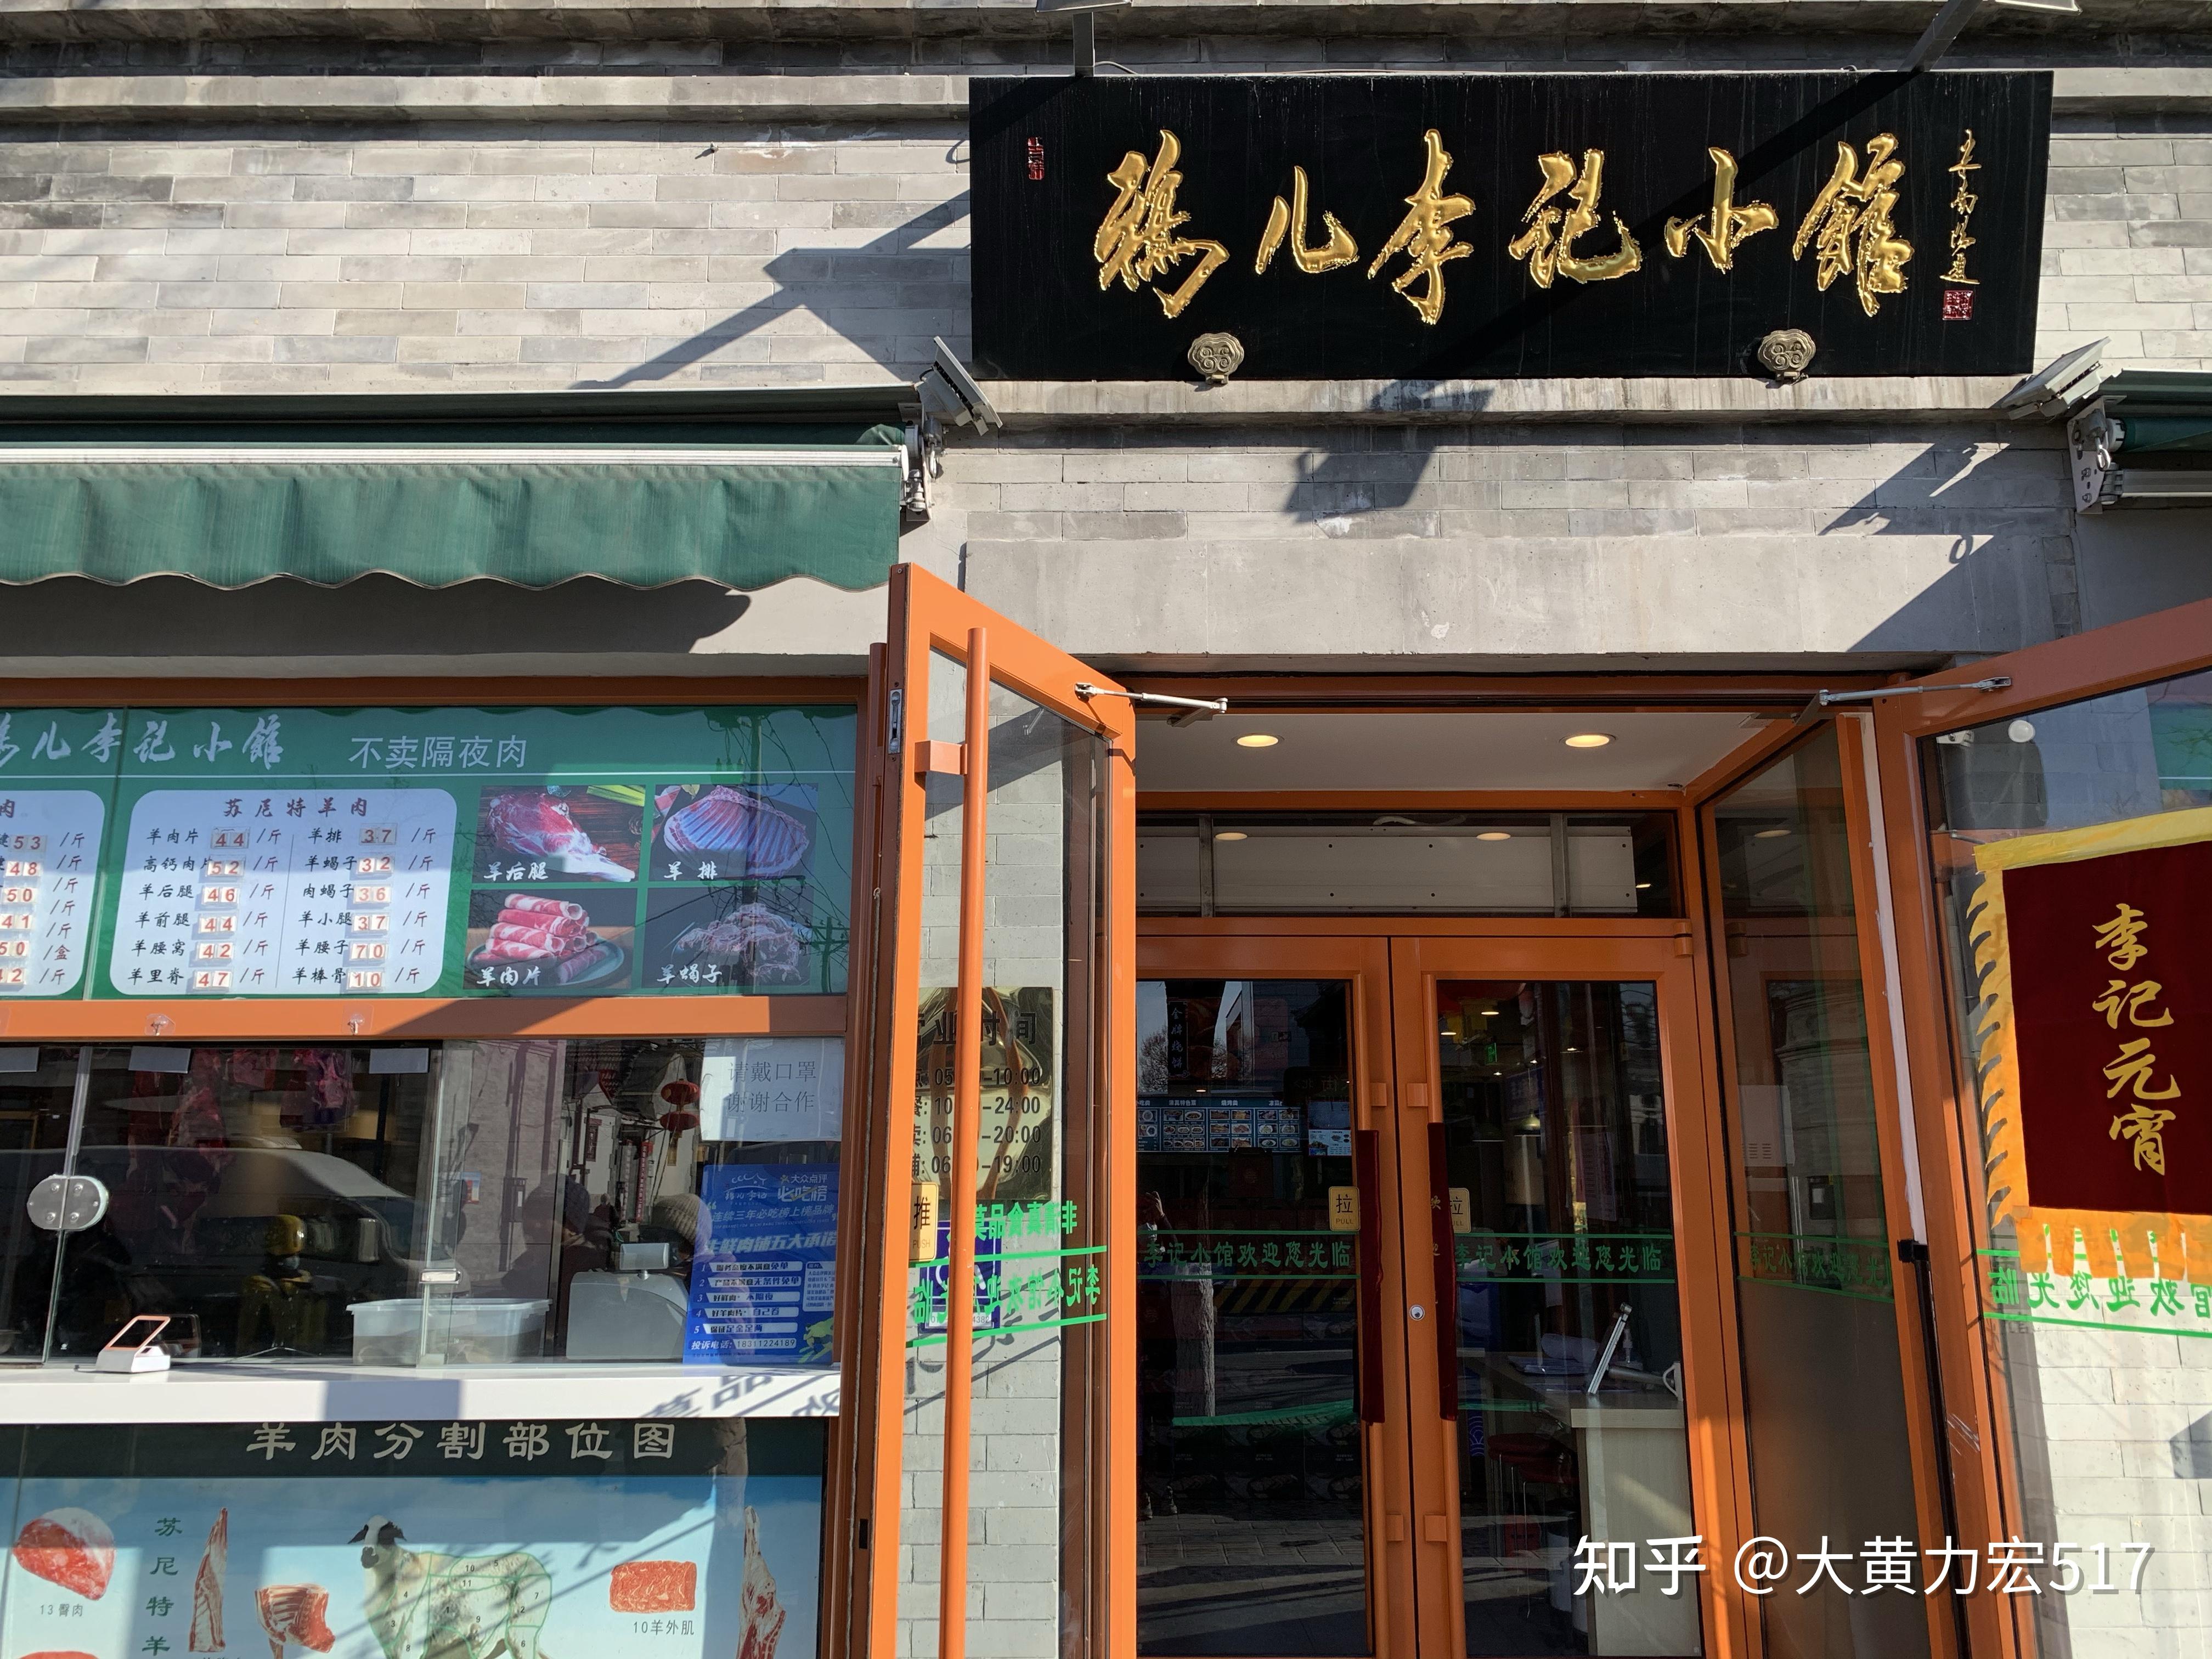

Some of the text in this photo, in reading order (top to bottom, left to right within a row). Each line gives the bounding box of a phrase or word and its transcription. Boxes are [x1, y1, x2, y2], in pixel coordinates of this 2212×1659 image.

[349, 735, 527, 769] 不卖隔夜肉
[224, 798, 368, 817] 苏尼特羊肉
[13, 836, 41, 850] 53
[147, 828, 199, 845] 羊肉片
[216, 833, 244, 847] 44
[308, 828, 342, 844] 羊排
[364, 829, 392, 843] 37
[9, 862, 37, 876] 48
[211, 861, 239, 874] 52
[305, 856, 357, 872] 羊蝎子
[362, 857, 390, 871] 32
[483, 861, 549, 881] 羊后腿
[663, 860, 718, 881] 羊排
[7, 888, 33, 902] 50
[139, 884, 194, 900] 羊后腿
[207, 888, 234, 901] 46
[303, 883, 354, 898] 肉蝎子
[359, 887, 386, 901] 36
[1, 915, 29, 929] 41
[135, 911, 190, 928] 羊前腿
[204, 917, 233, 931] 44
[298, 911, 353, 928] 羊小腿
[358, 916, 386, 930] 37
[0, 941, 25, 956] 50
[131, 939, 185, 956] 羊腰窝
[202, 944, 230, 958] 42
[295, 939, 349, 956] 羊腰子
[357, 944, 385, 958] 70
[127, 968, 184, 986] 羊里脊
[198, 972, 228, 986] 47
[292, 967, 346, 985] 羊棒骨
[354, 973, 381, 986] 10
[476, 966, 540, 988] 羊肉片
[656, 964, 723, 985] 羊蝎子
[2092, 903, 2181, 1176] 李记元宵
[728, 1060, 817, 1082] 请戴口罩
[725, 1091, 816, 1113] 谢谢合作
[791, 1173, 828, 1184] 大众点评
[1335, 1193, 1354, 1214] 拉
[913, 1196, 931, 1231] 推
[913, 1239, 930, 1249] PUSH
[1144, 1240, 1351, 1268] 李记小馆欢迎您光临
[1455, 1243, 1662, 1273] 李记小馆欢迎您光临
[246, 1421, 675, 1461] 羊肉分割部位图
[40, 1602, 84, 1617] 13臀肉
[632, 1620, 695, 1636] 10羊外肌
